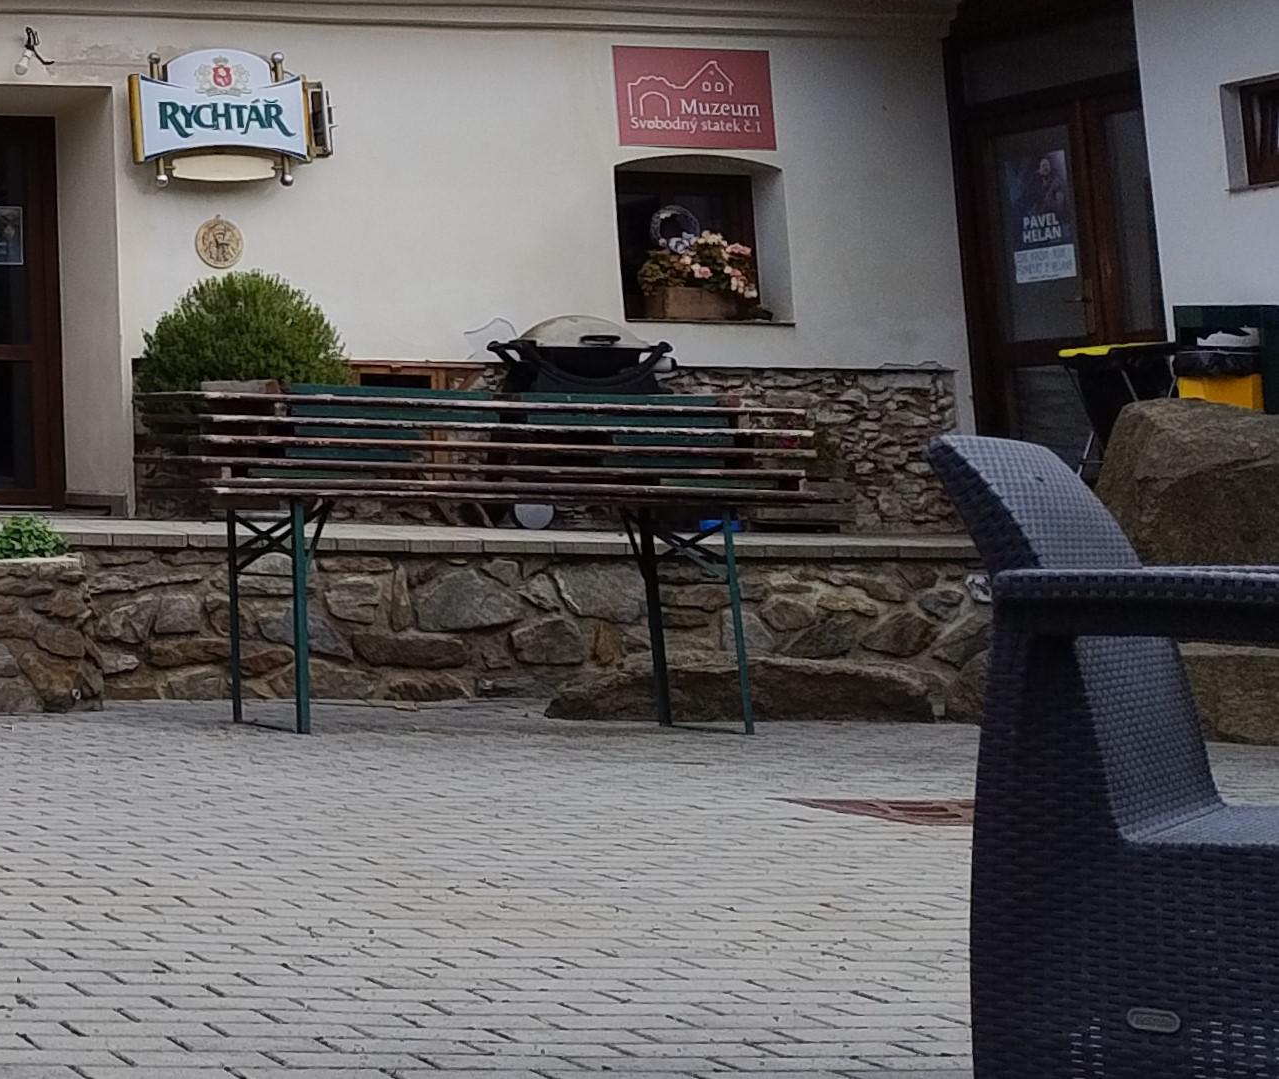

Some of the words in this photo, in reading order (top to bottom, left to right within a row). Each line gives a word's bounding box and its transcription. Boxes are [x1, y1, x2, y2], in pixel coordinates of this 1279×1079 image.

[680, 98, 760, 117] Muzeum
[158, 98, 296, 138] RYCHTÁŘ
[630, 115, 698, 134] Svobodný
[701, 119, 741, 133] statek
[1022, 213, 1060, 229] PAVEL
[1022, 225, 1062, 244] HELAN
